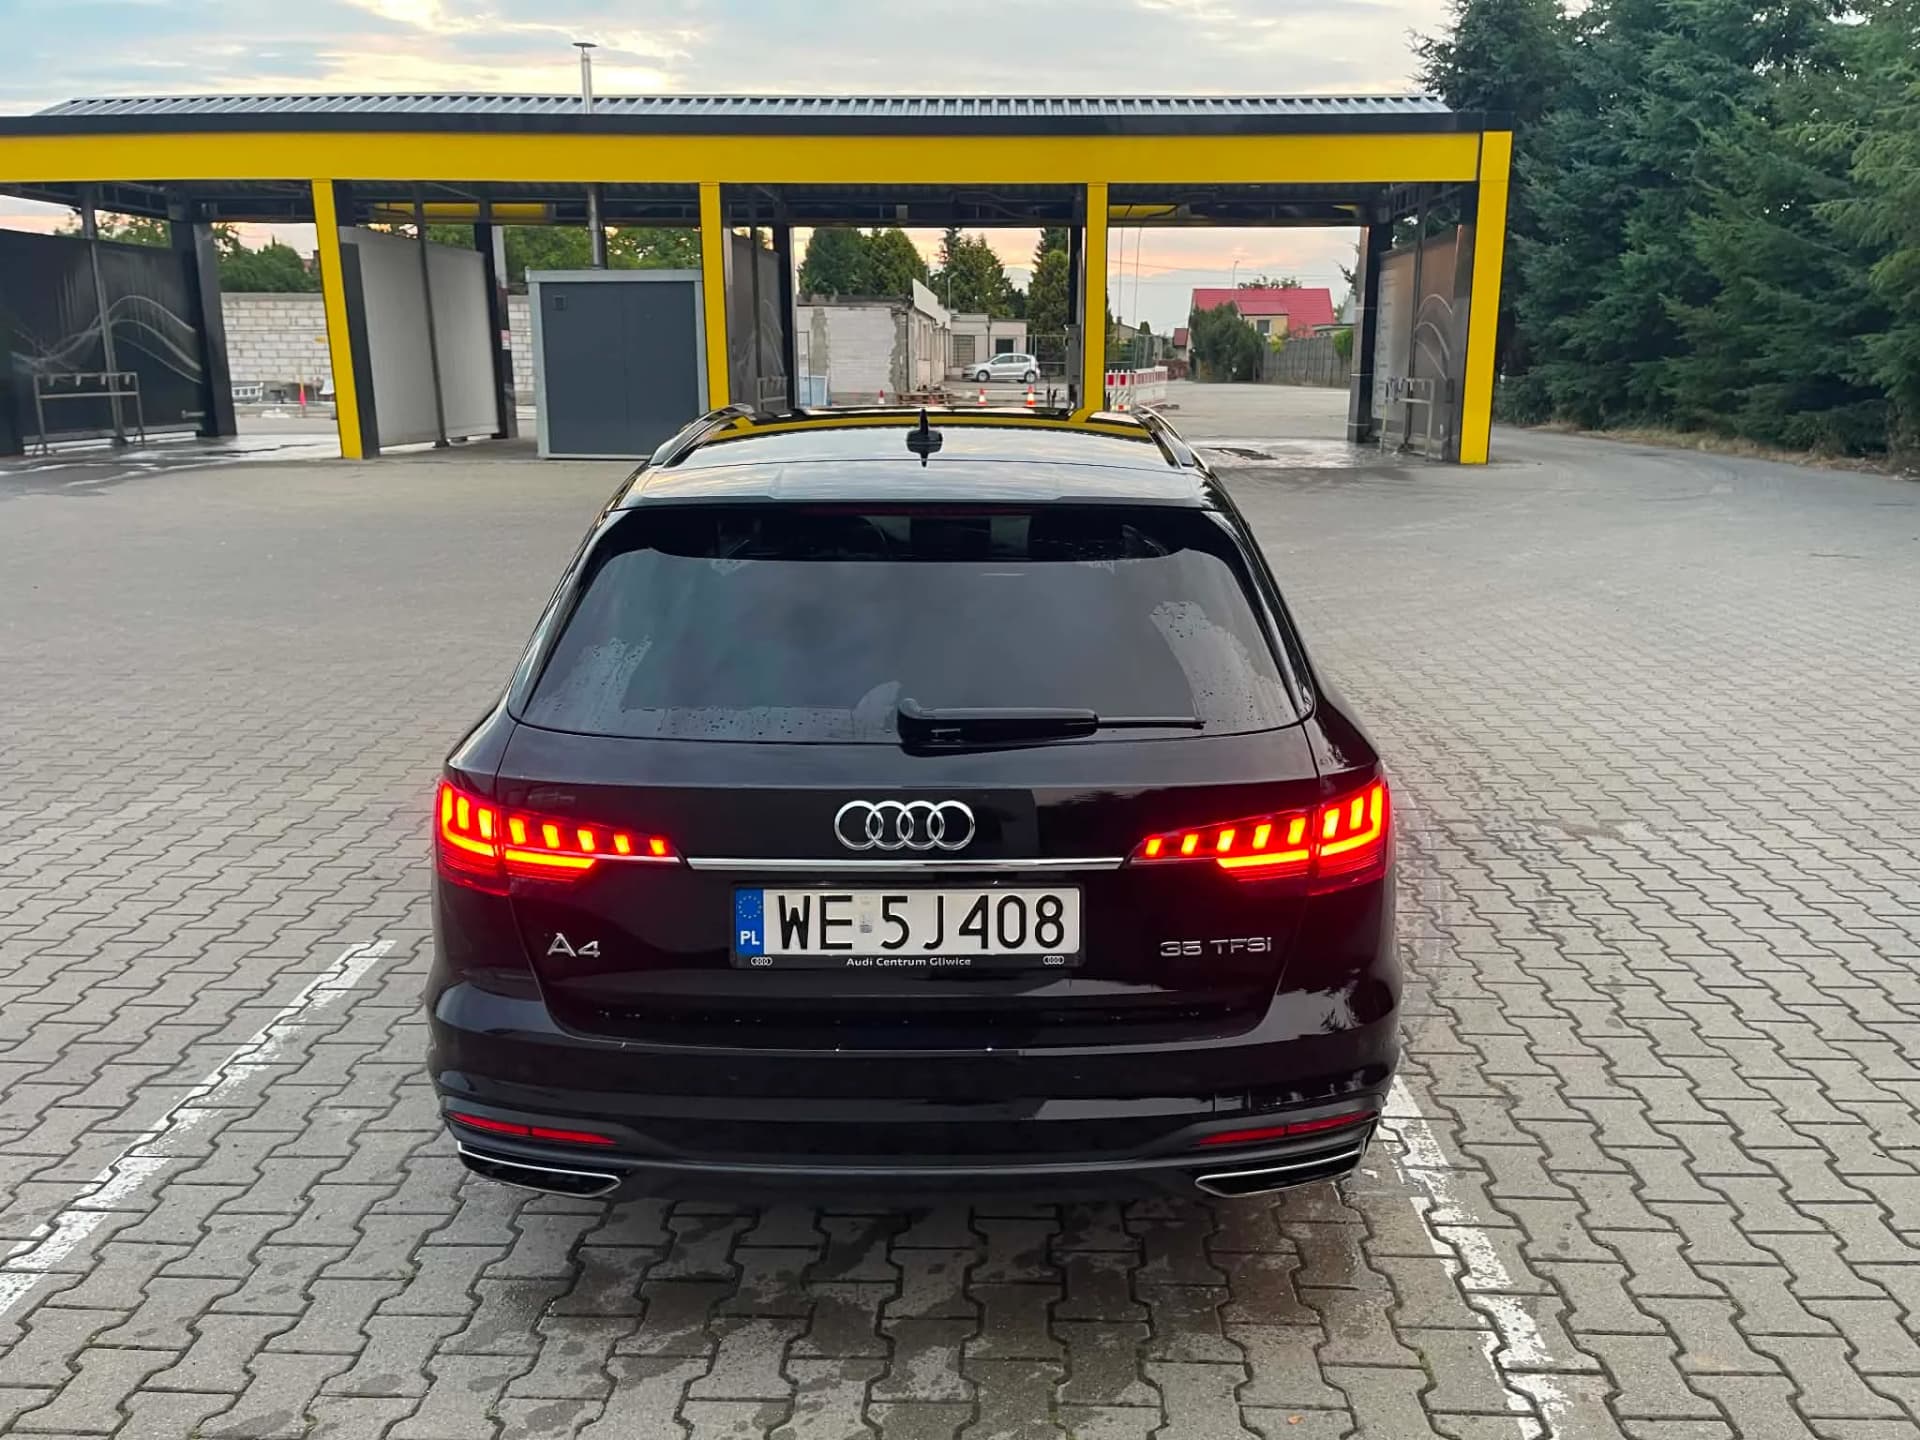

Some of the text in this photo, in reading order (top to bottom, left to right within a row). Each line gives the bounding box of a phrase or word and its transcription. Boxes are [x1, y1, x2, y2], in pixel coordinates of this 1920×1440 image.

[778, 895, 1065, 949] WE 5J408
[547, 933, 601, 957] A4
[740, 931, 760, 945] PL
[1160, 941, 1202, 956] 35
[846, 957, 971, 966] Audi Centrum Gliwice
